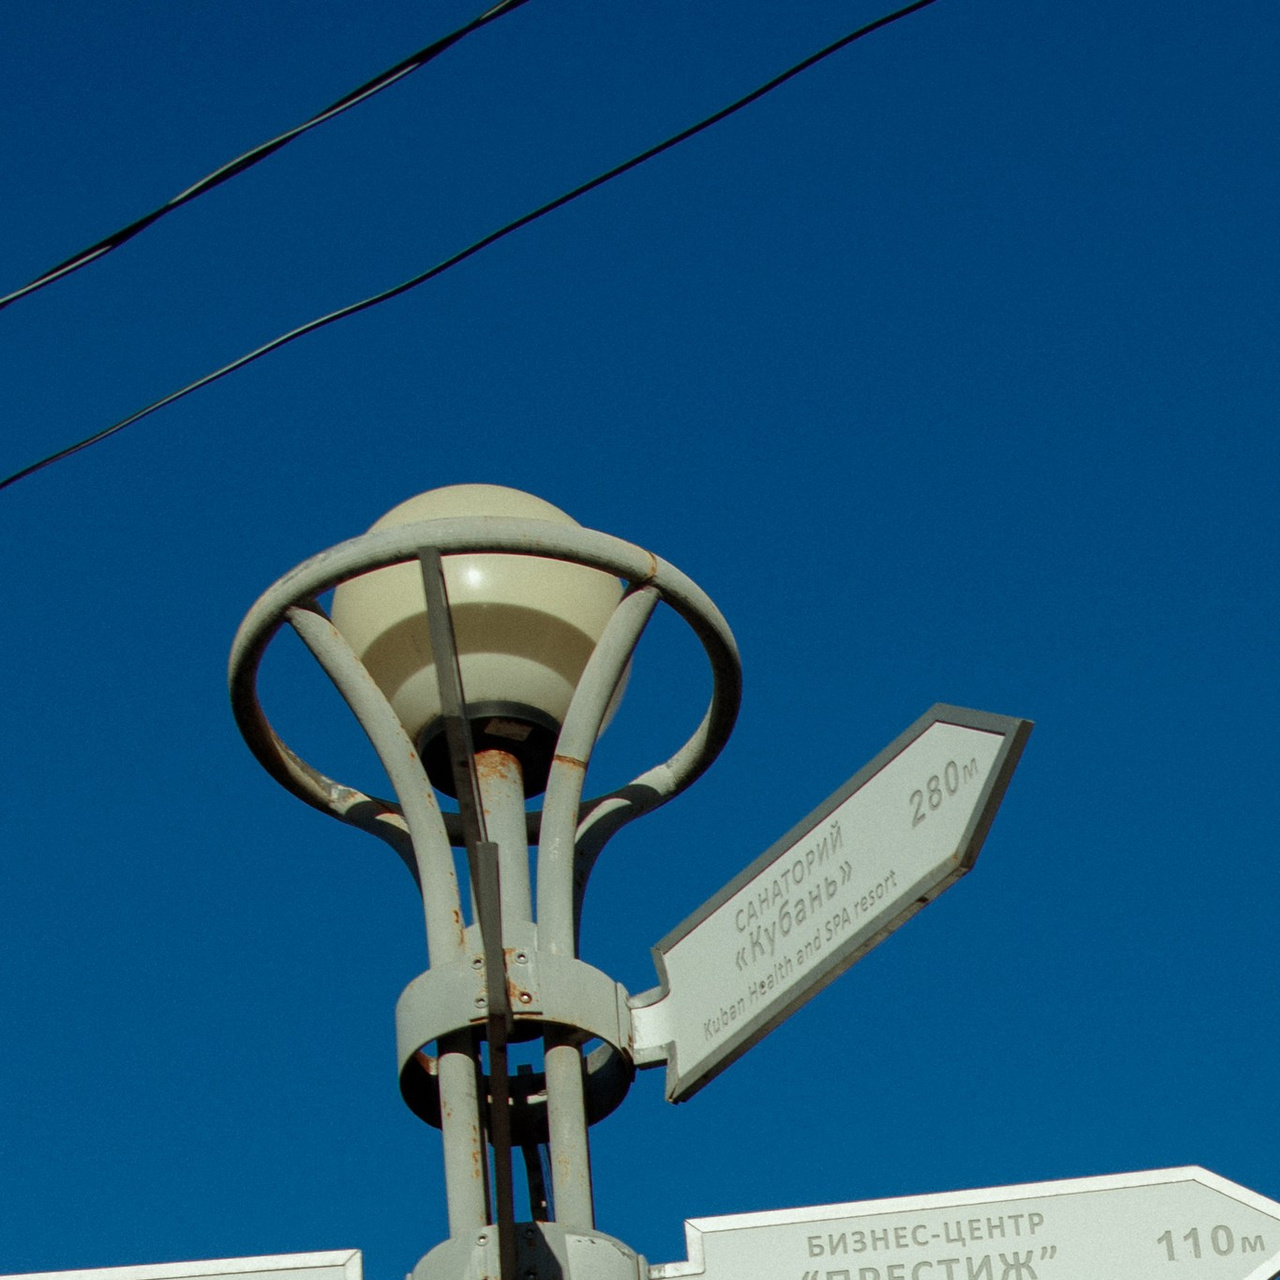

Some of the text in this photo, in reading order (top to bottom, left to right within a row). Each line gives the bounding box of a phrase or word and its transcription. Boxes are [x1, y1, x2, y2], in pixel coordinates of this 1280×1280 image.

[734, 820, 844, 934] САНАТОРИЙ
[734, 860, 853, 972] «Кубань»
[703, 869, 898, 1042] Kuban Health and SPA resort
[806, 1212, 1045, 1258] БИЗНЕС-ЦЕНТР
